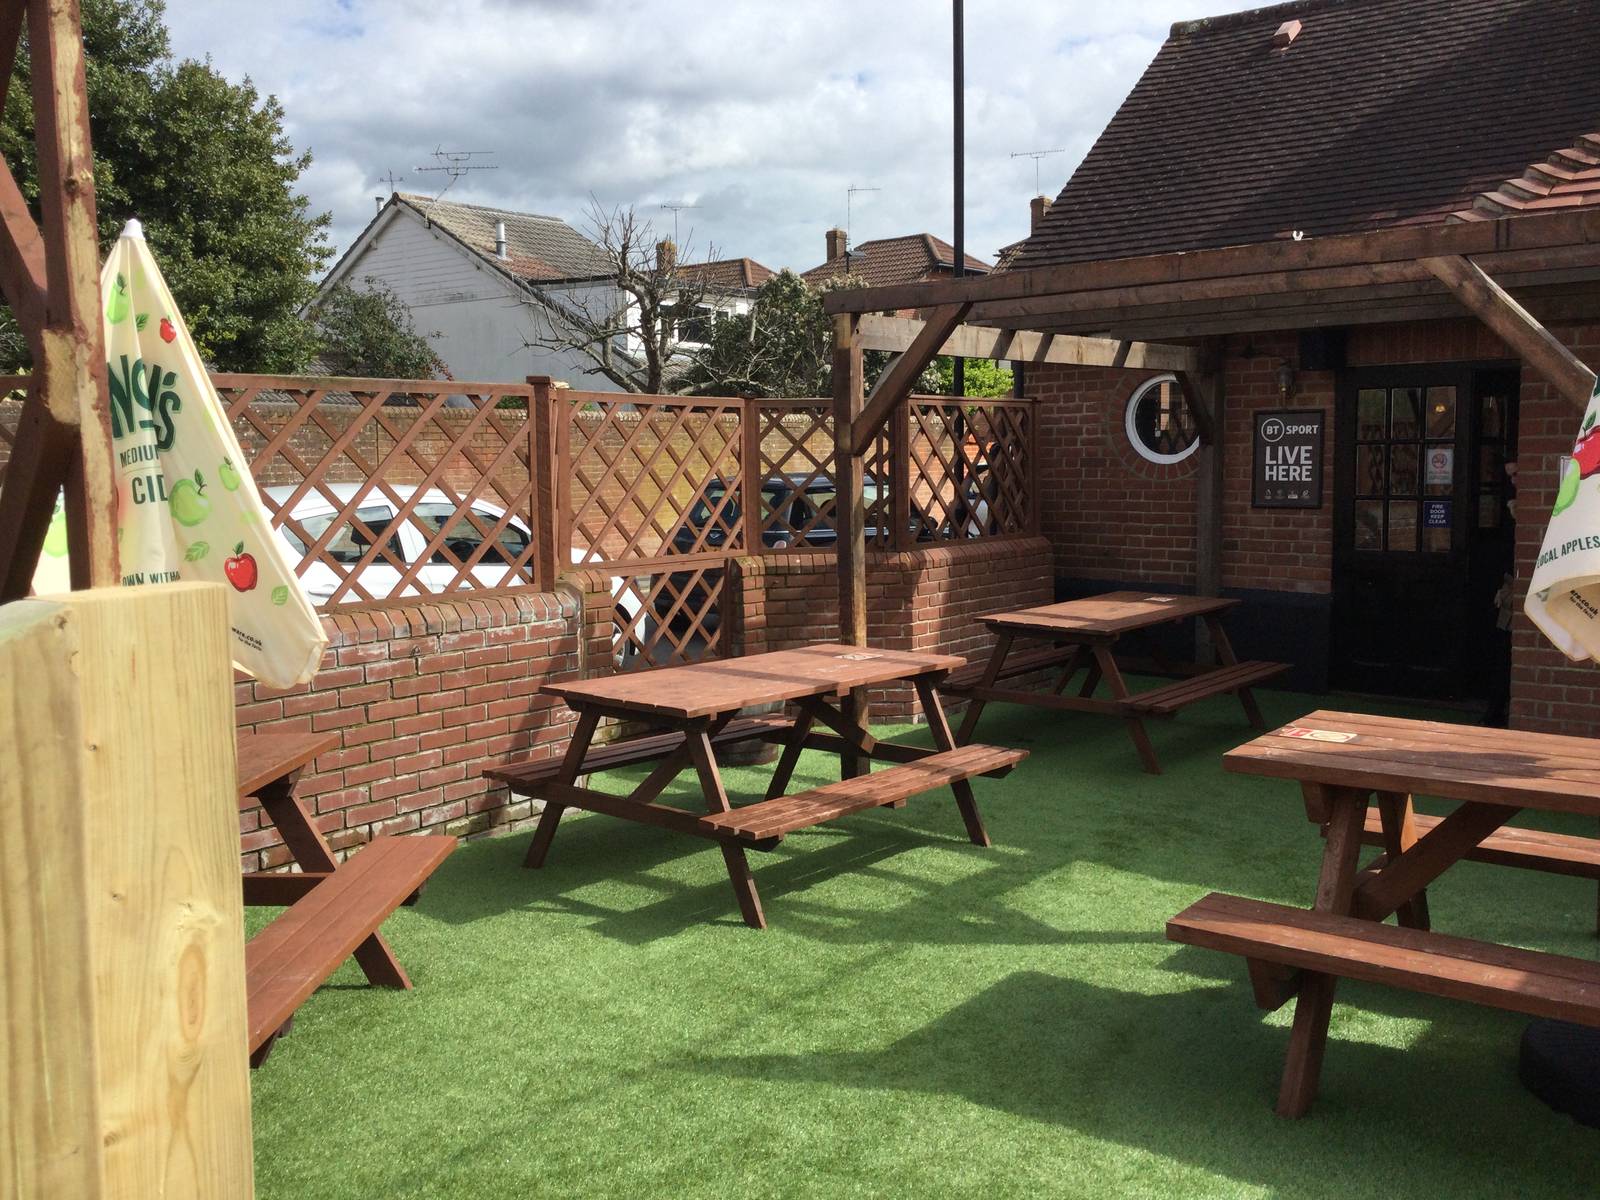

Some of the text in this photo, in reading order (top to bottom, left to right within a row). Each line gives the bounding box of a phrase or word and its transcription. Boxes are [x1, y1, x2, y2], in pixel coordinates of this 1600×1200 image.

[1266, 425, 1318, 435] BT SPORT
[1265, 446, 1312, 464] LIVE
[1265, 465, 1312, 481] HERE
[1561, 536, 1600, 556] APPLES
